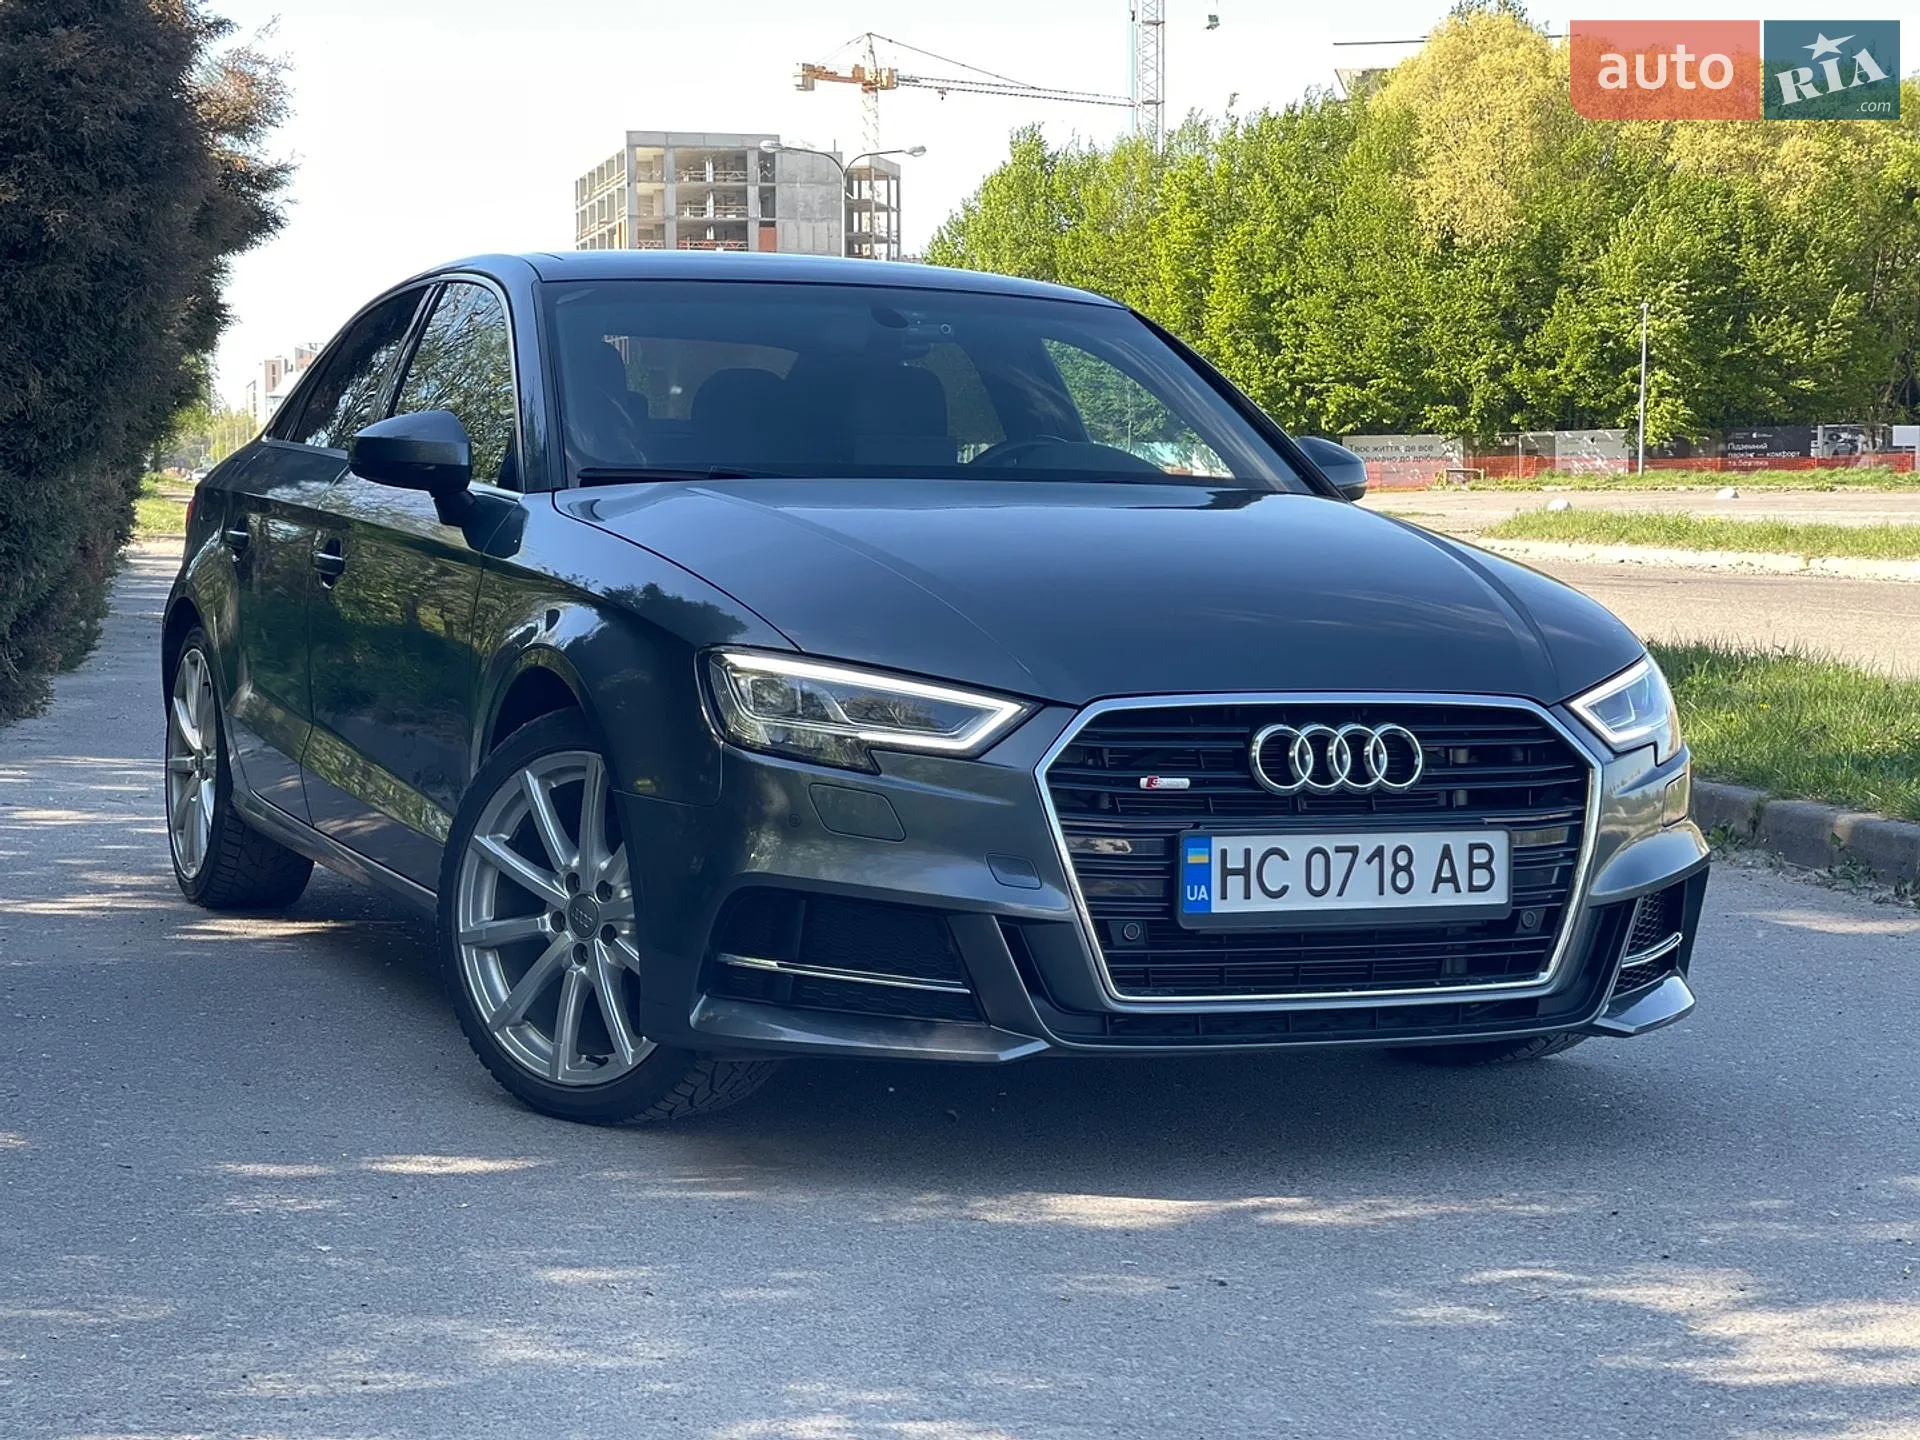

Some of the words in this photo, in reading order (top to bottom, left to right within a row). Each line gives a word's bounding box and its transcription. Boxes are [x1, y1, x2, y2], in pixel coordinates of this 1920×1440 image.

[1186, 884, 1209, 902] UA
[1218, 846, 1291, 901] HC
[1304, 843, 1416, 898] 0718
[1430, 841, 1497, 894] AB
